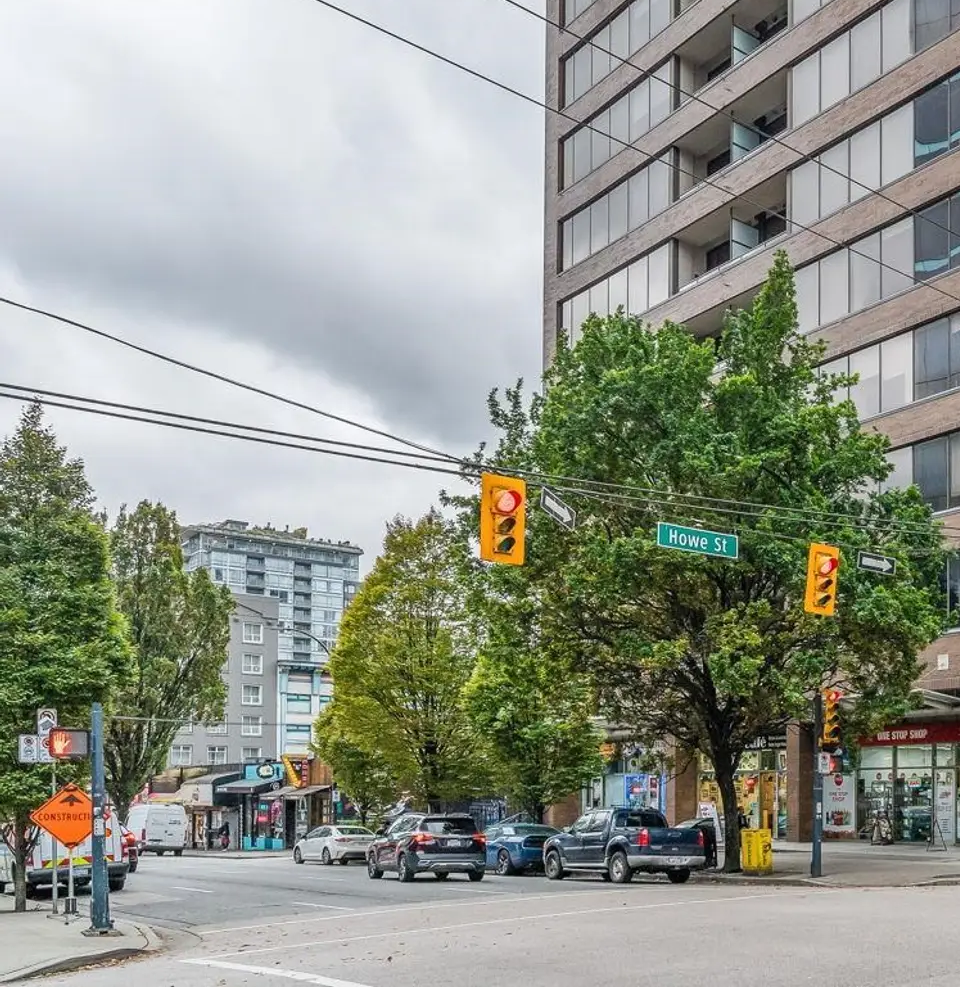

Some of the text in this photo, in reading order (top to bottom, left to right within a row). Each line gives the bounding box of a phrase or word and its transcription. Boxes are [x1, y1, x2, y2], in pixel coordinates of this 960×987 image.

[669, 528, 728, 553] Howe St
[877, 729, 928, 741] ONE STOP SHOP
[39, 813, 91, 821] CONSTRUCTI
